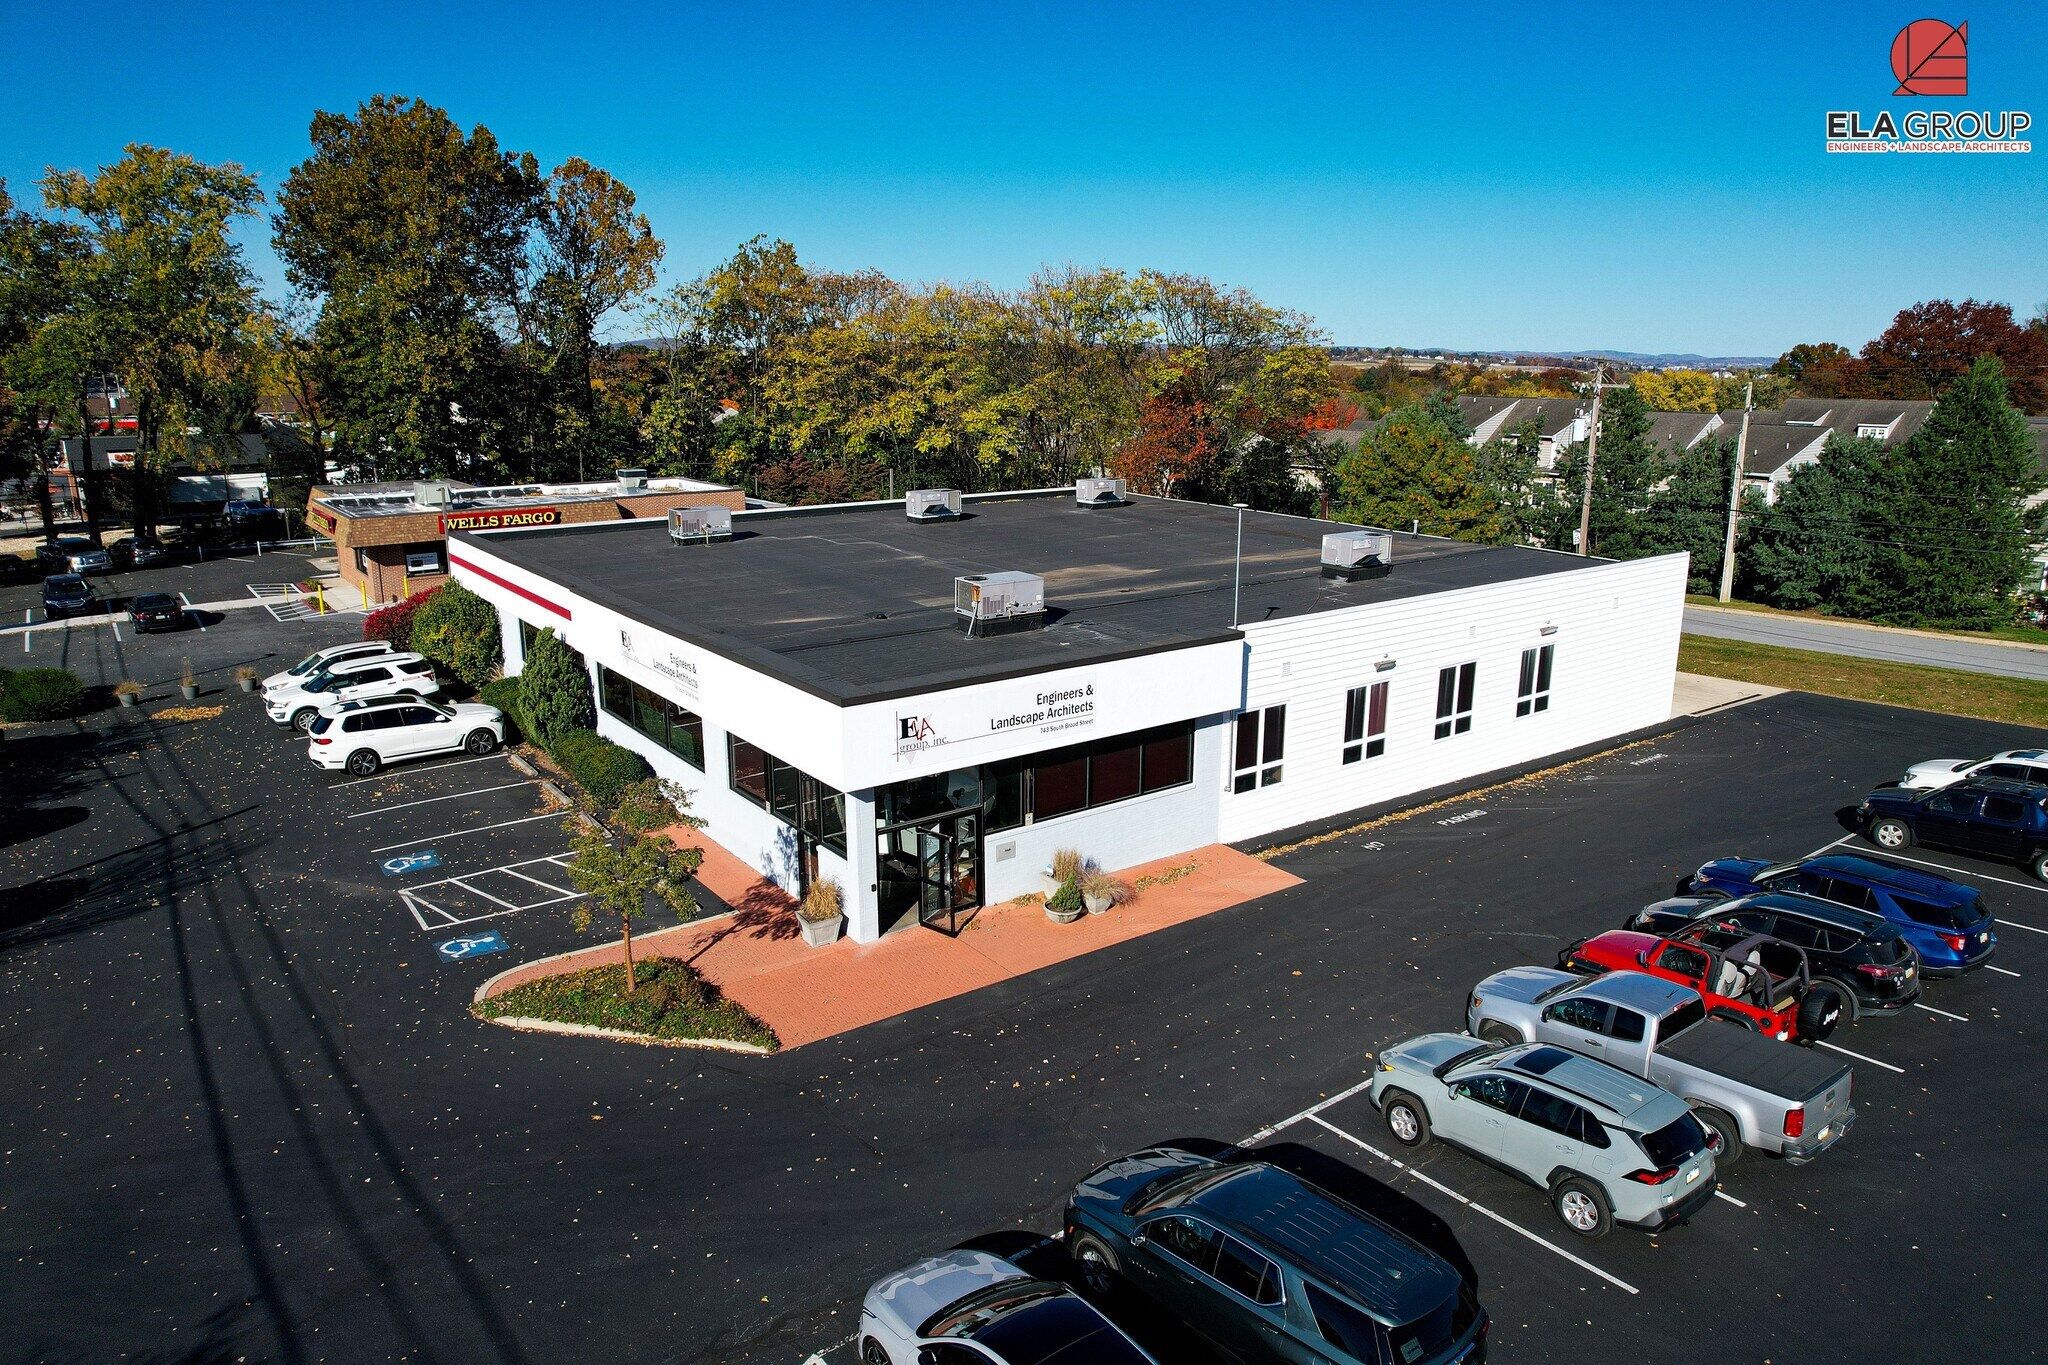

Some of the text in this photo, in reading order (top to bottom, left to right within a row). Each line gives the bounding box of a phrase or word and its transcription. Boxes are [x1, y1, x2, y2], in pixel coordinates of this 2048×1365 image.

[442, 511, 555, 530] WELLS FARGO
[1036, 684, 1094, 705] Engineers &
[990, 701, 1094, 730] Landscape Architects
[1050, 724, 1064, 732] South
[1065, 721, 1079, 729] Broad
[1079, 718, 1094, 726] Street
[899, 735, 950, 756] group, inc.
[1436, 809, 1488, 827] PARKING
